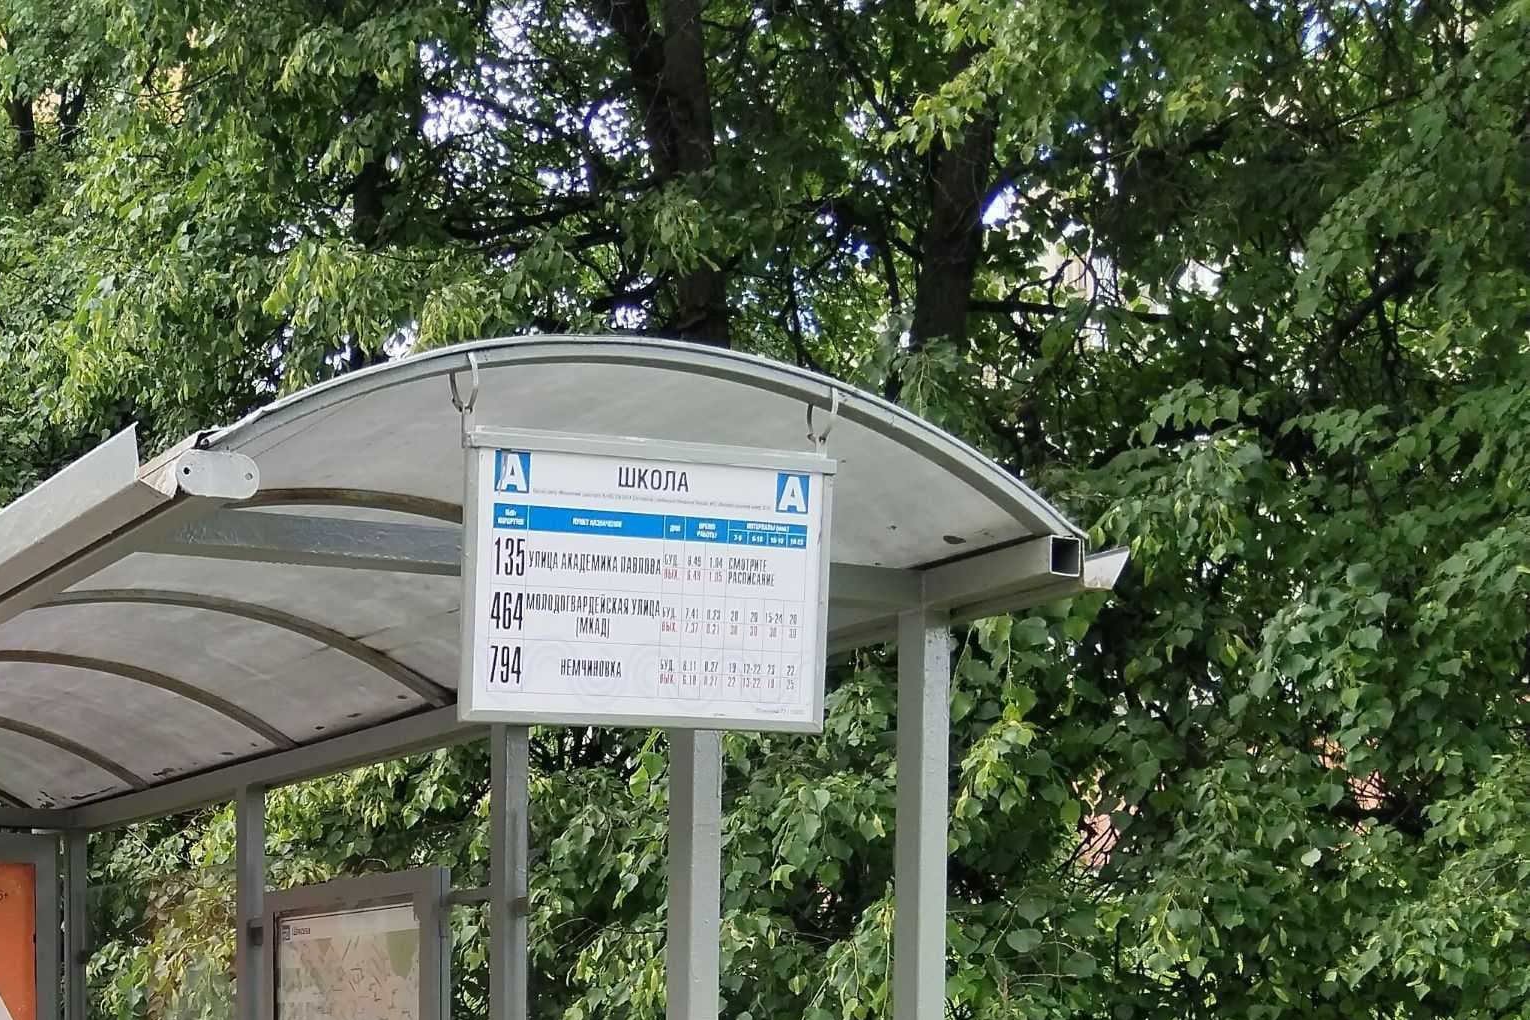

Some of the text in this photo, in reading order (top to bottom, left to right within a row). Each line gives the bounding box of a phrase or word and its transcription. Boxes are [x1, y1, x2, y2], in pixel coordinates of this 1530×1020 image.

[618, 466, 689, 493] ШКОЛА
[495, 536, 661, 577] 135 УЛИЦА АКАДЕМИКА ПАВЛОВА
[728, 557, 767, 571] СМОТРИТЕ
[728, 571, 774, 587] РАСПИСАНИЕ
[490, 591, 661, 631] 464 МОЛОДОГВАРДЕЙСКАЯ УЛИЦА
[576, 617, 610, 638] (МКАД)
[490, 645, 621, 684] 794 НЕМЧИНОВКА
